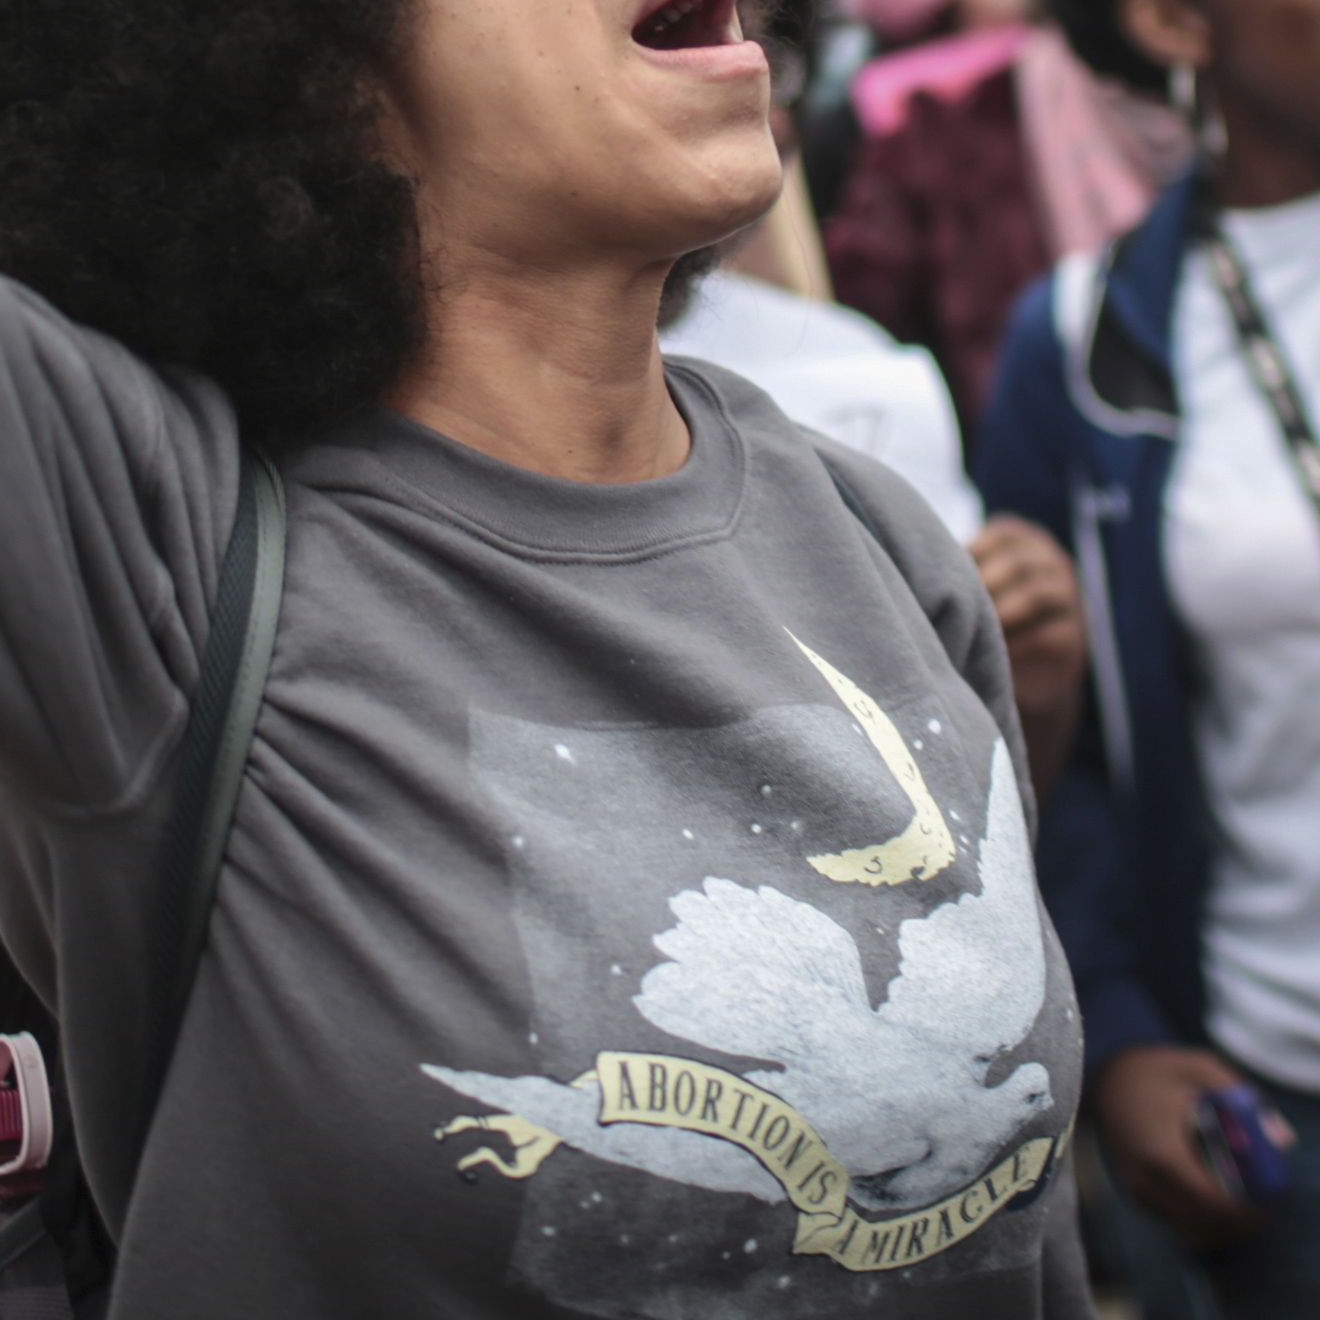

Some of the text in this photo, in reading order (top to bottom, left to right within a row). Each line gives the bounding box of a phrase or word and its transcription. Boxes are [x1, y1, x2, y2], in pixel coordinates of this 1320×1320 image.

[617, 1060, 838, 1207] ABORTION IS
[833, 1143, 1035, 1267] A MIRACLE
